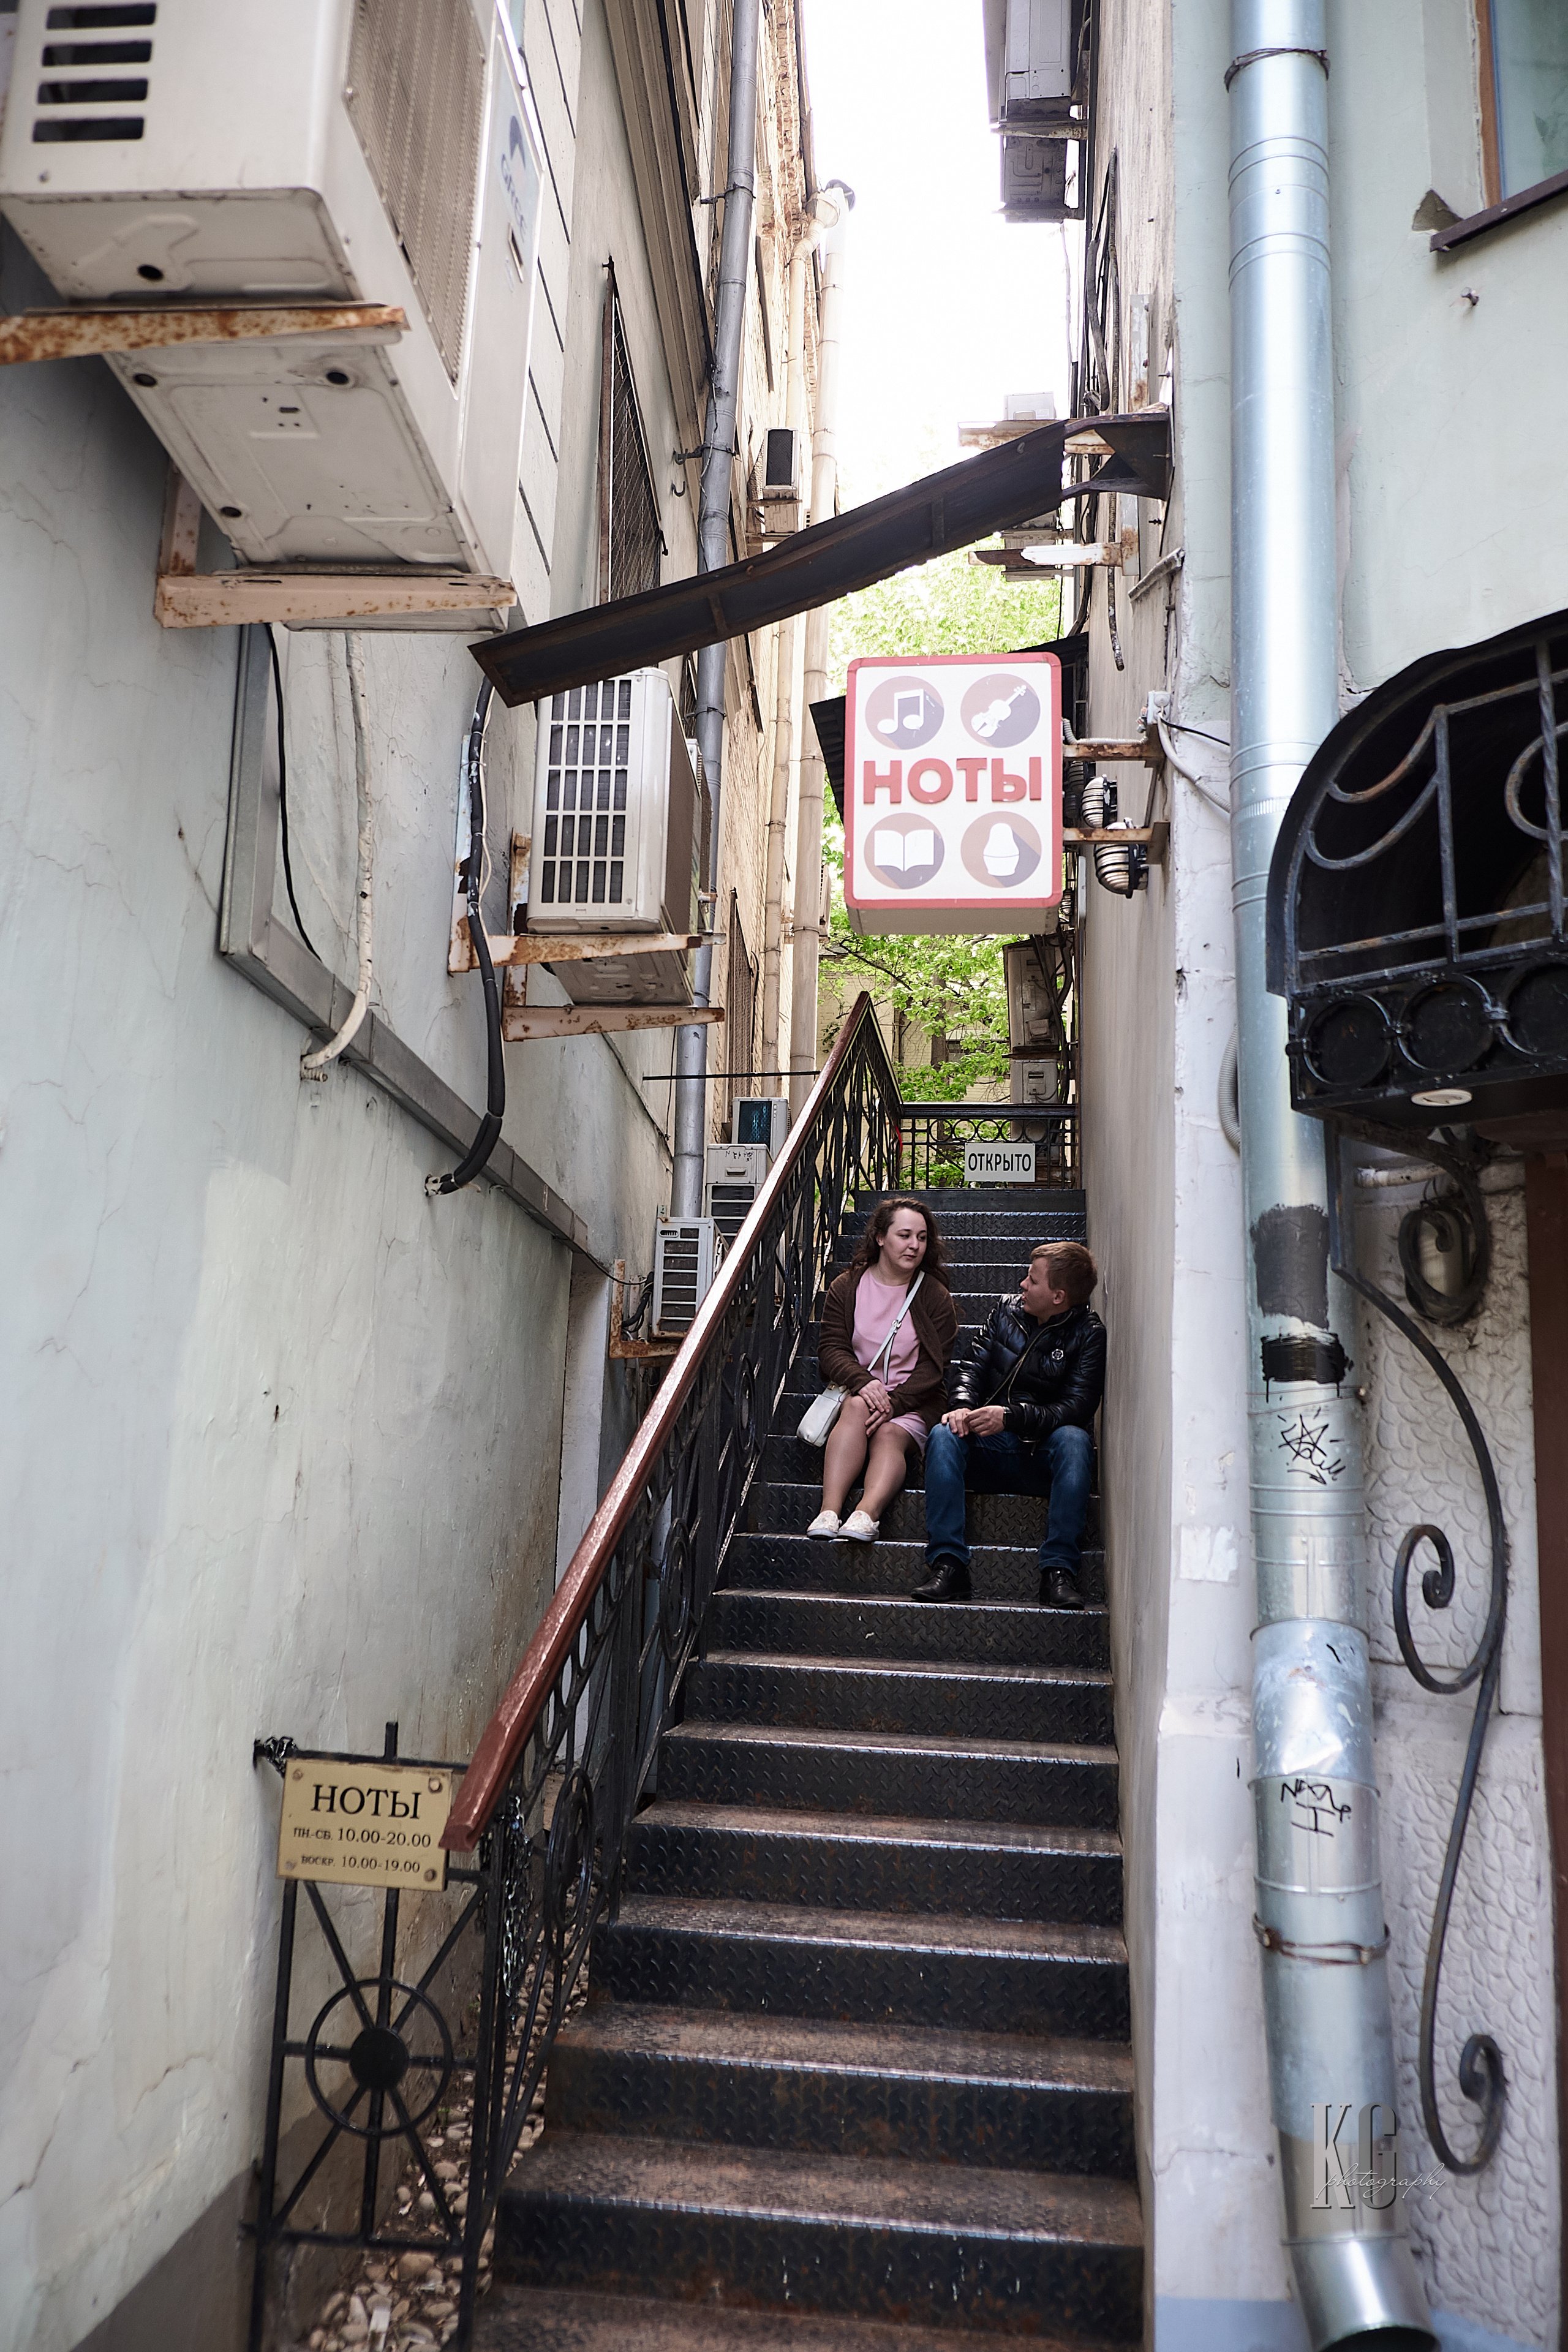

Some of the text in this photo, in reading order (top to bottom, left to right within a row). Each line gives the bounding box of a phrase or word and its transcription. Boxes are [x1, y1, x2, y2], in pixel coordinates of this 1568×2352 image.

[501, 154, 527, 243] GREE
[863, 756, 1042, 804] НОТЫ
[968, 1153, 1031, 1172] ОТКРЫТО
[311, 1784, 422, 1819] НОТЫ
[337, 1828, 431, 1847] 10.00-20.00
[341, 1856, 420, 1873] 10.00-19.00
